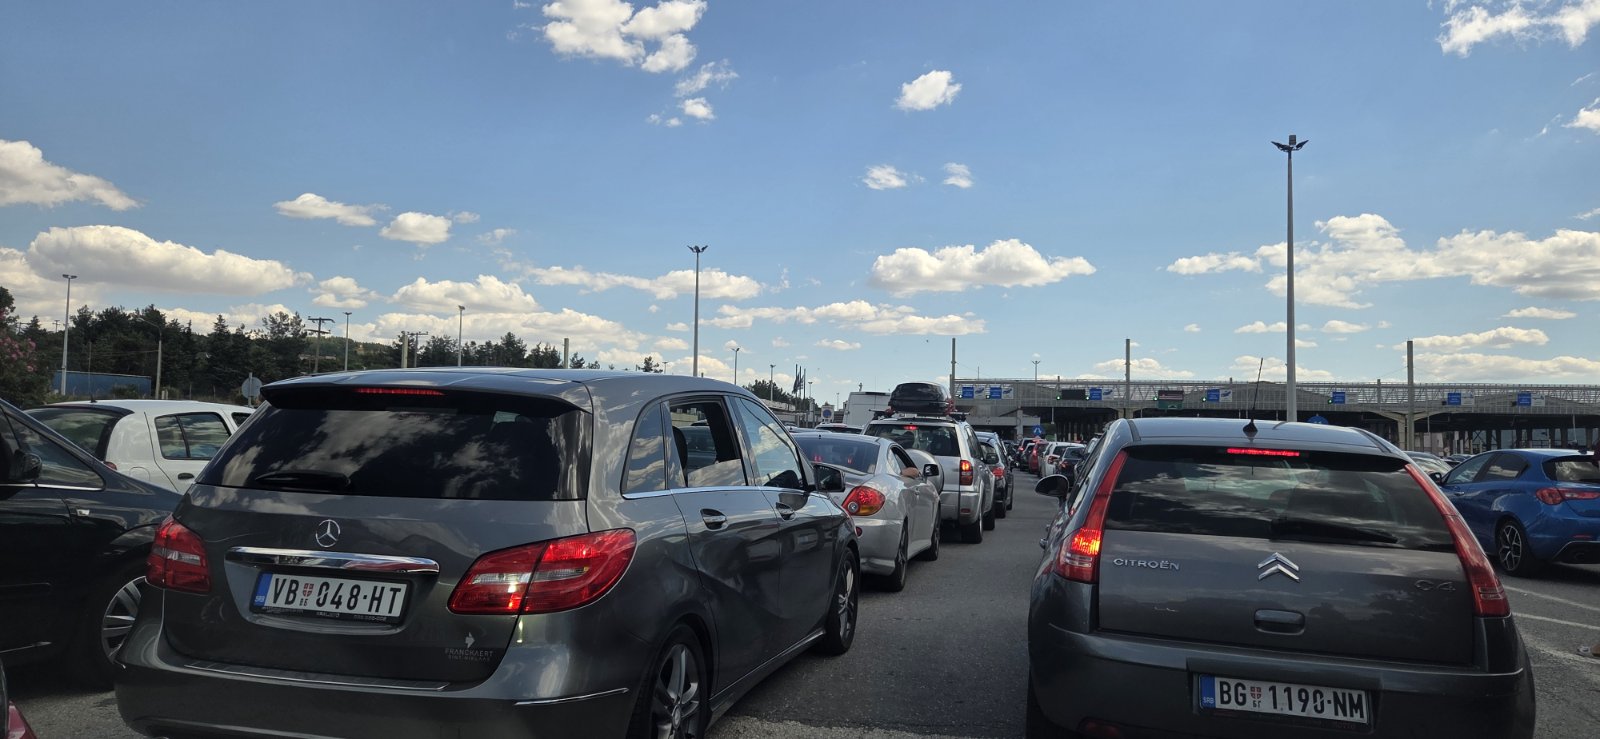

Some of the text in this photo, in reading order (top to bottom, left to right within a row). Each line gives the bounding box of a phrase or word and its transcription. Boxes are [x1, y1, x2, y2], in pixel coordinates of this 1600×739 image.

[1113, 557, 1180, 571] CITROËN
[273, 578, 300, 605] VB
[1219, 680, 1247, 706] BG
